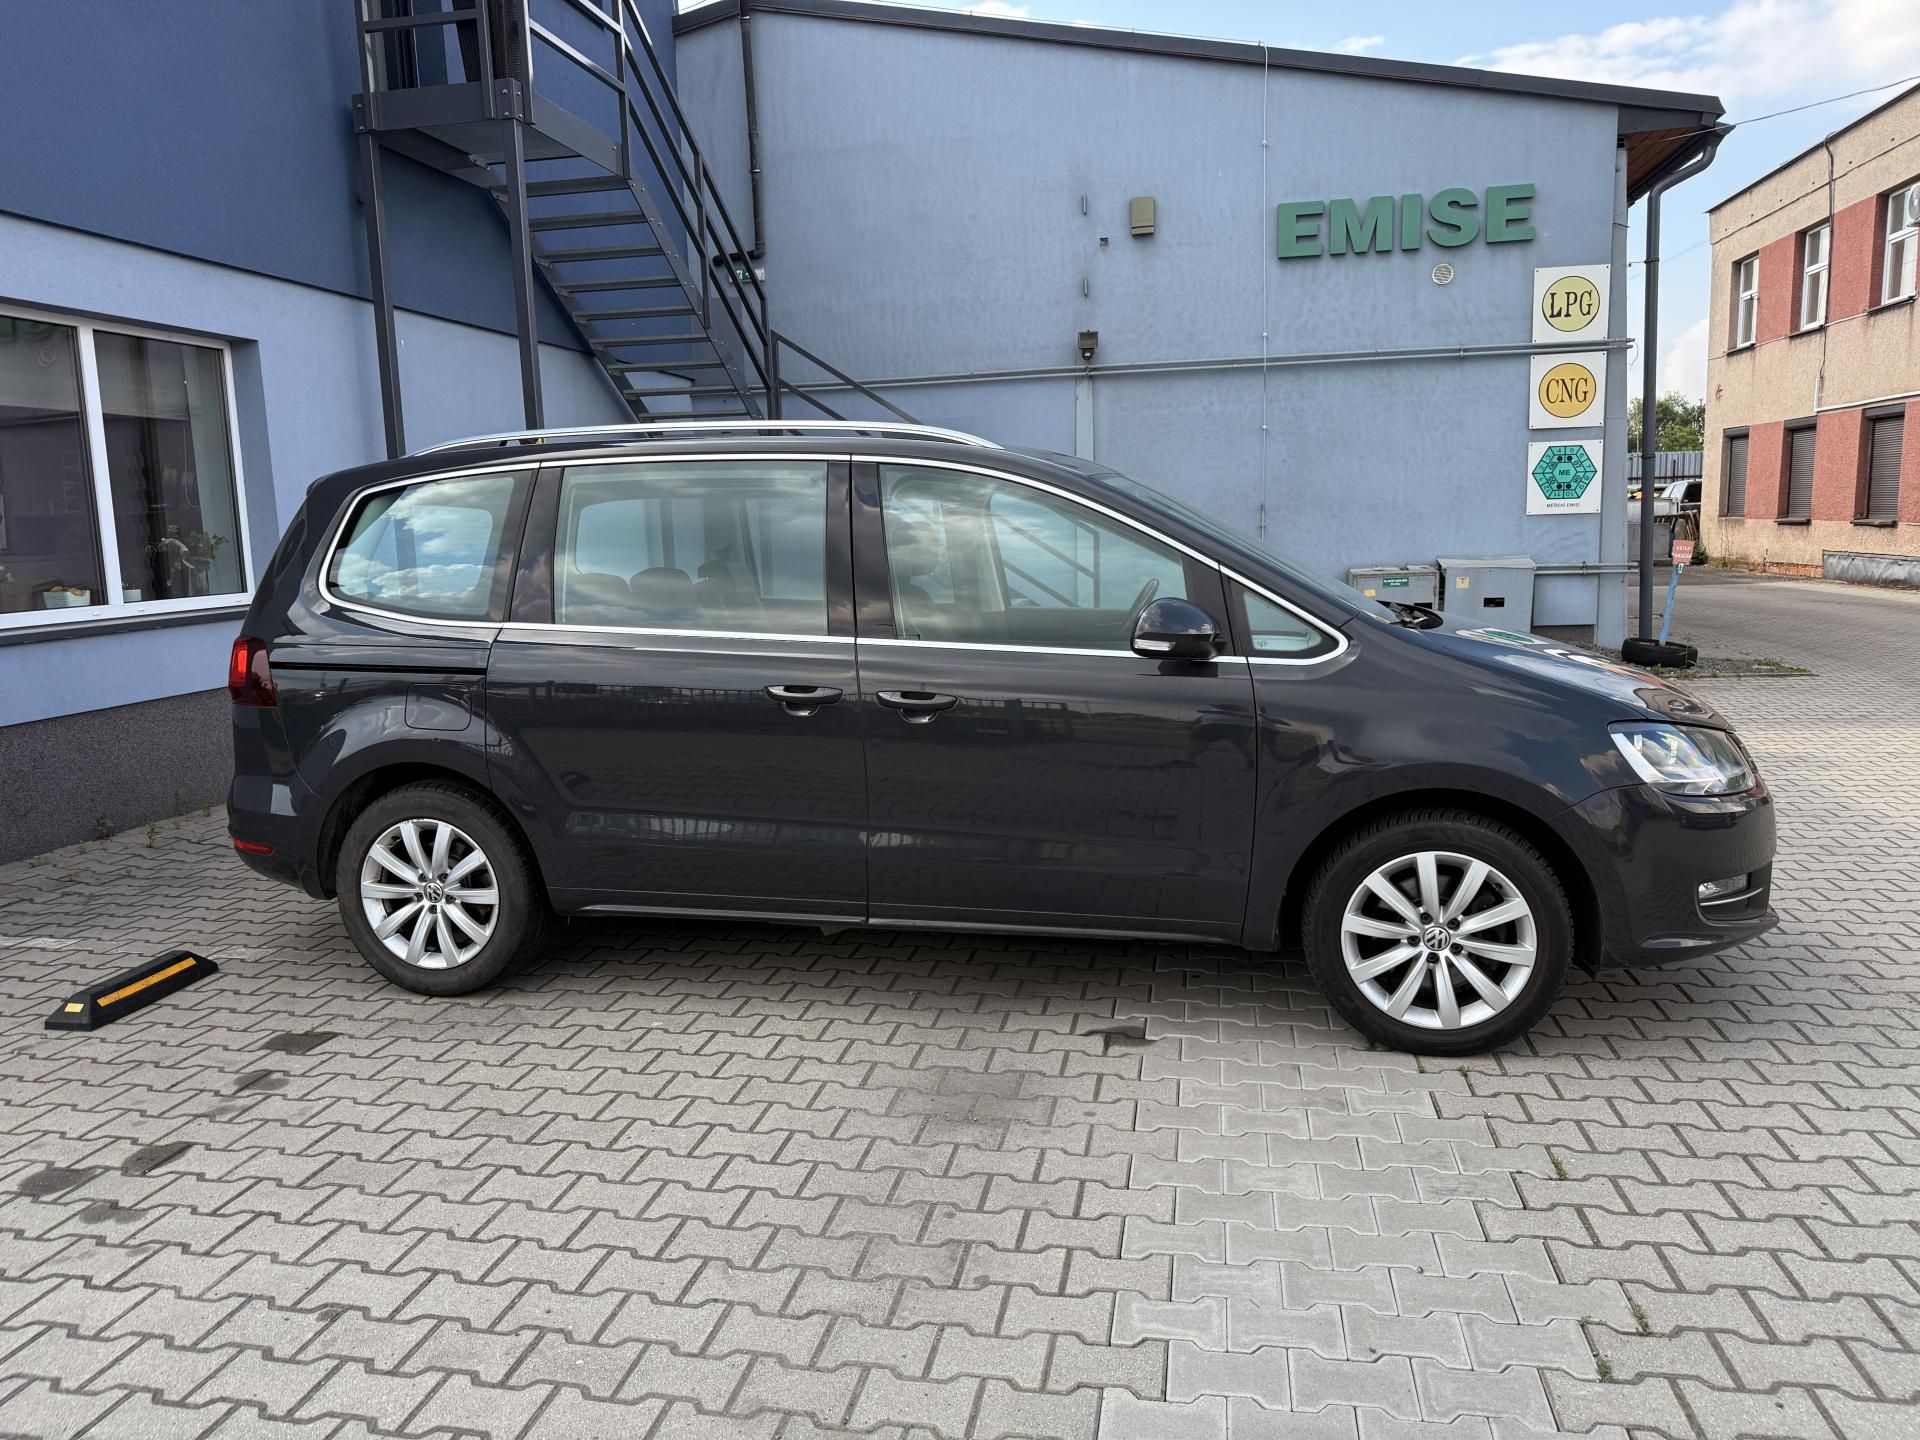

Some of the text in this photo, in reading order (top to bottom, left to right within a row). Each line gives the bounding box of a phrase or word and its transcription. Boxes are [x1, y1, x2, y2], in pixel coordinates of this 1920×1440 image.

[1278, 183, 1536, 259] EMISE
[1549, 290, 1593, 318] LPG
[1546, 378, 1588, 403] CNG
